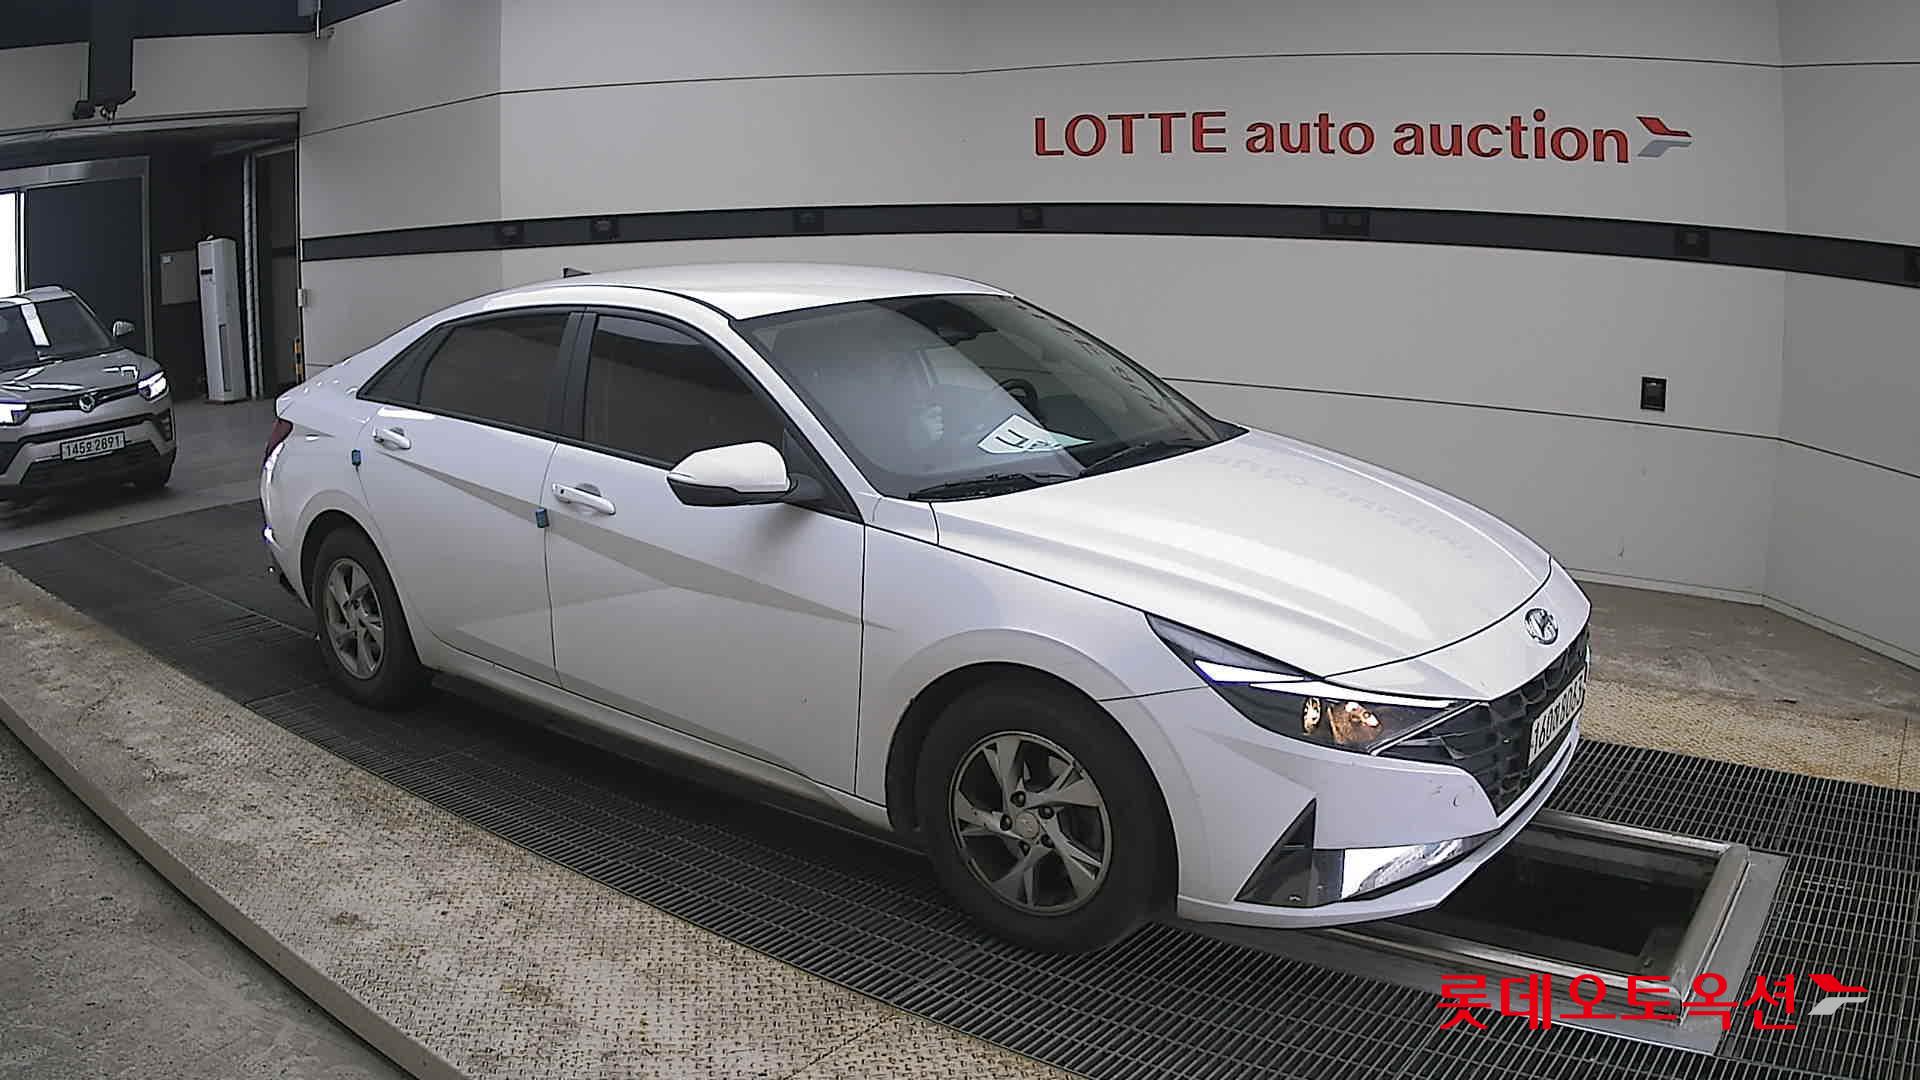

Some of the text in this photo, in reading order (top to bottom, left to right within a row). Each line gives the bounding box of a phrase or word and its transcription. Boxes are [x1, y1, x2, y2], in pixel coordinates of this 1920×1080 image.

[1032, 109, 1631, 163] LOTTE auto auction
